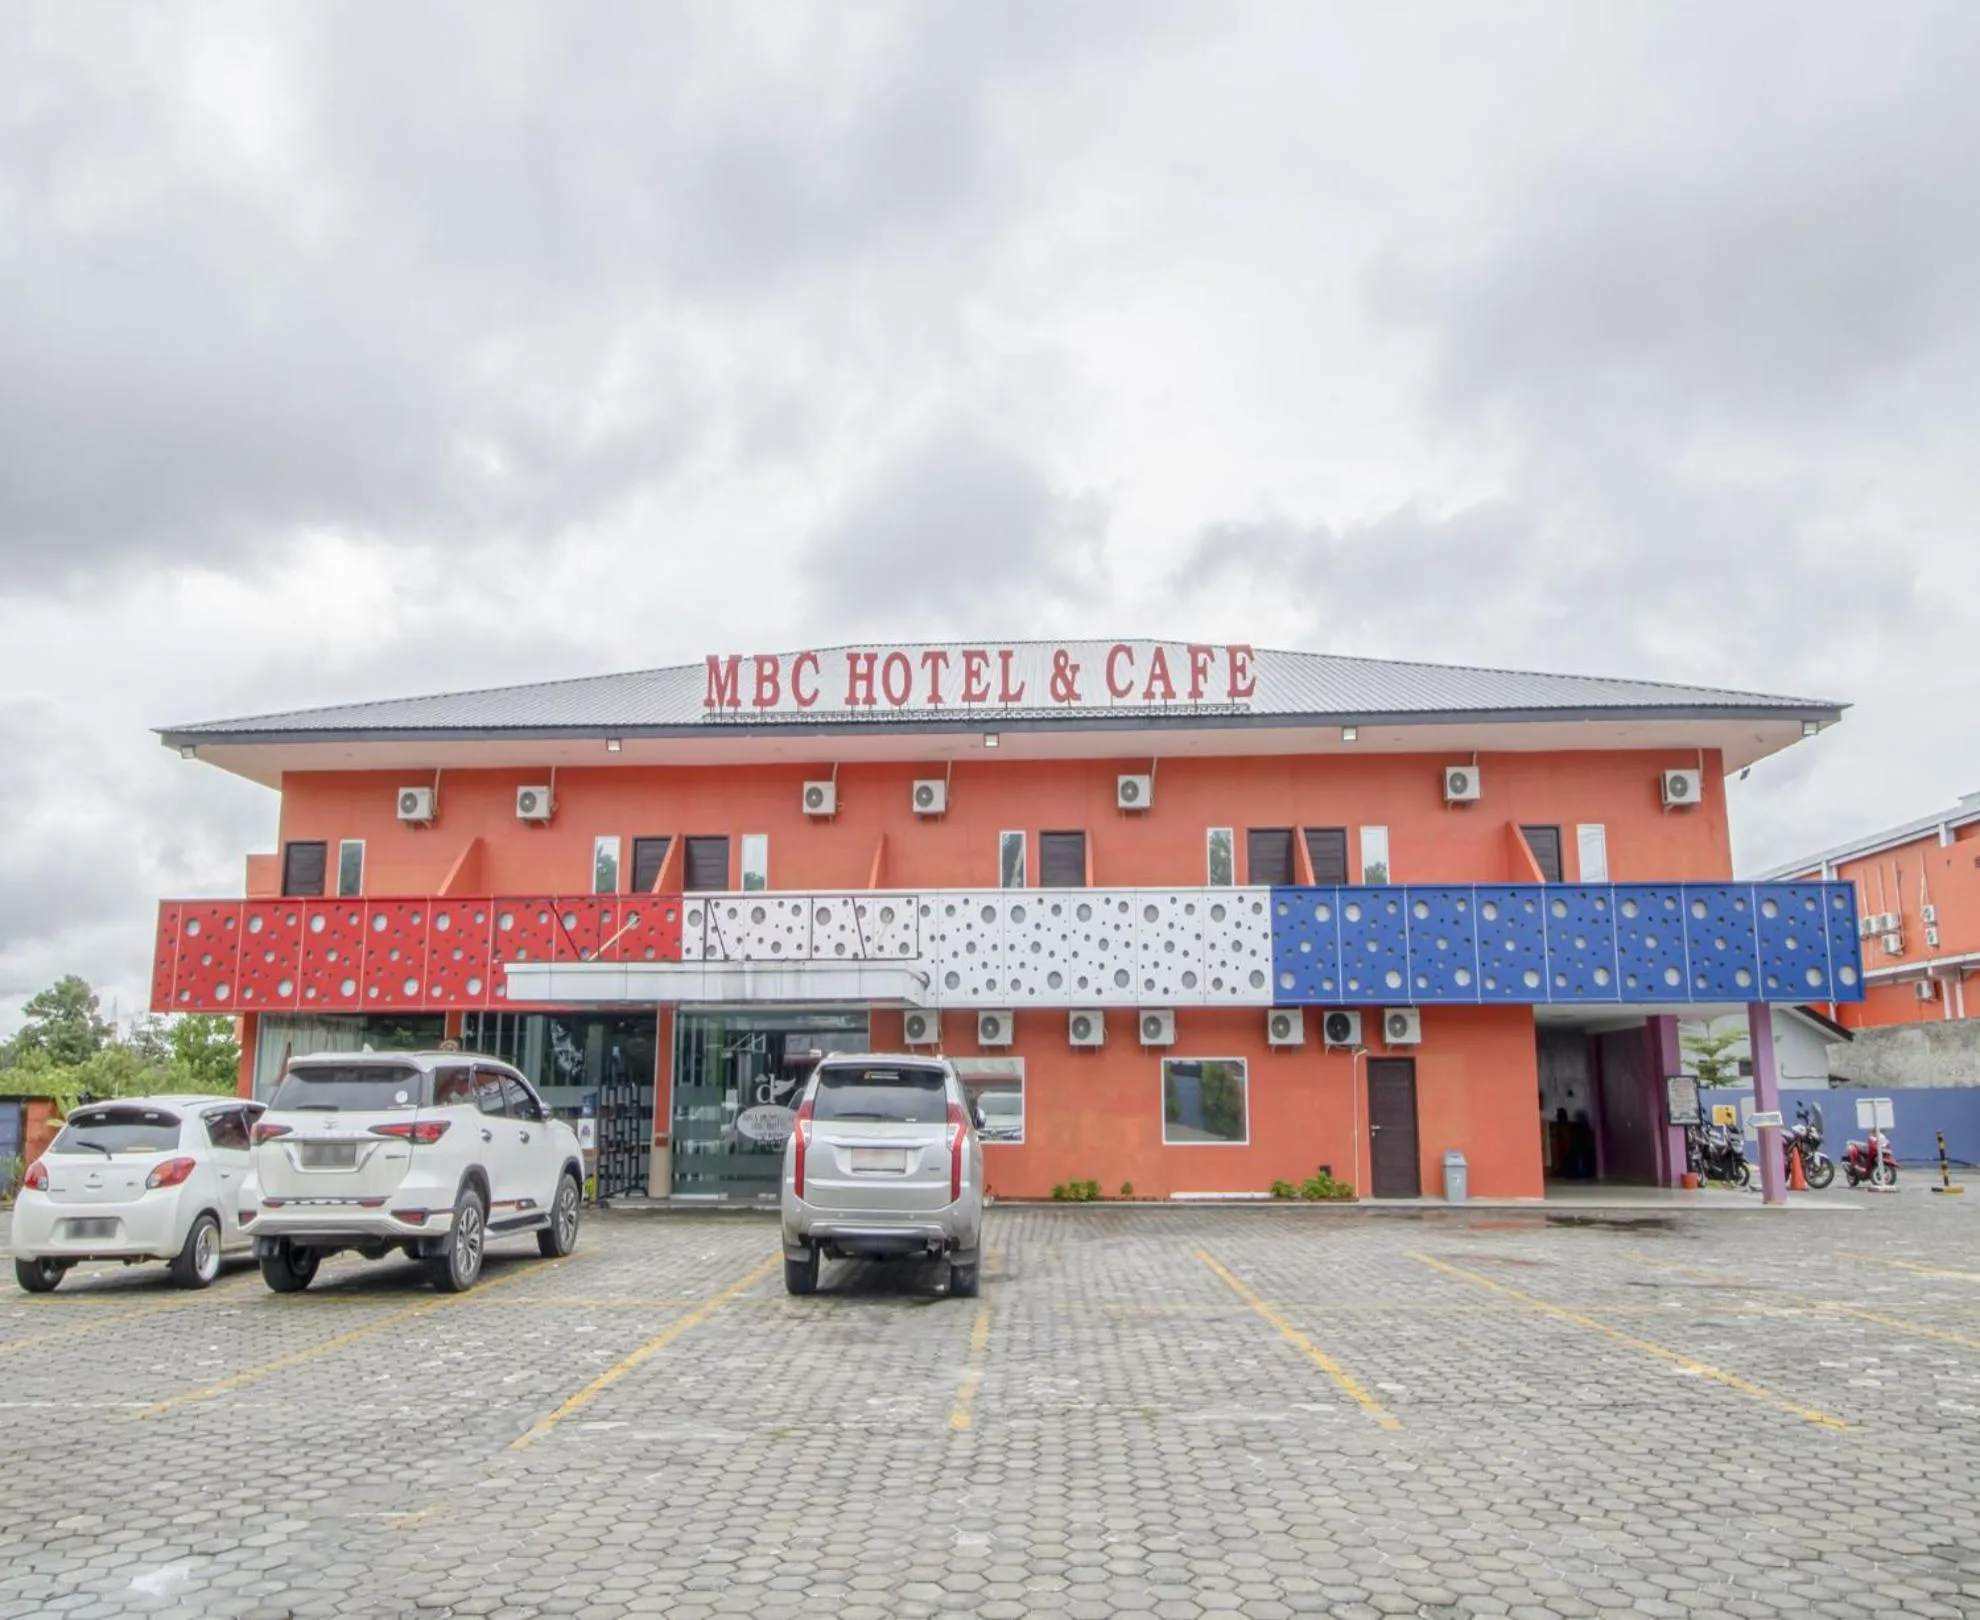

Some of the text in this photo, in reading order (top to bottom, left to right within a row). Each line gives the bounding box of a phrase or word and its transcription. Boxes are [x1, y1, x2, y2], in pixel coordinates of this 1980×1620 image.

[703, 644, 1256, 707] MBC HOTEL & CAFE
